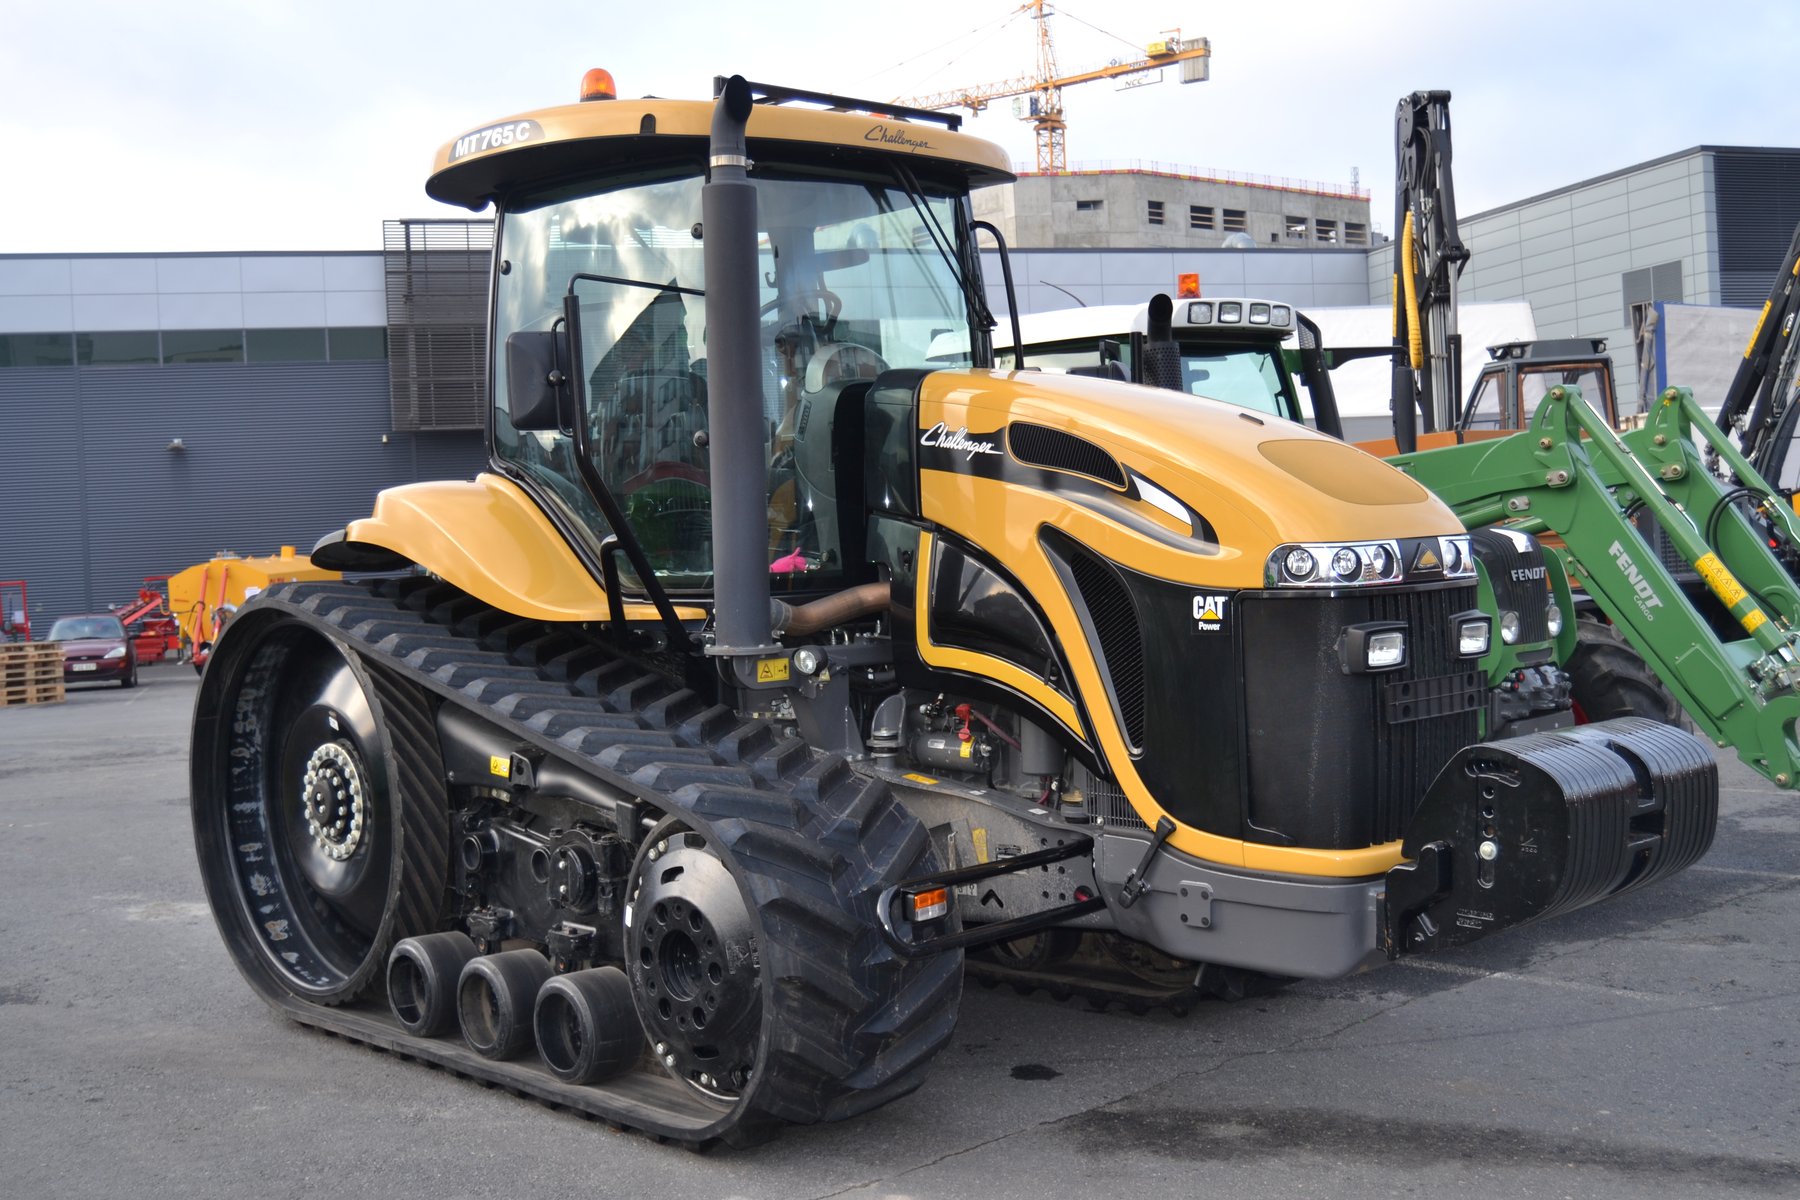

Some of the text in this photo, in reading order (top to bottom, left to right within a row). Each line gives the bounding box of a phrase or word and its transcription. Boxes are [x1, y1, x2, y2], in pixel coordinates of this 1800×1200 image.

[864, 124, 938, 152] Challenger
[920, 421, 1004, 461] Challenger
[1510, 566, 1546, 581] FENDT
[1608, 540, 1663, 608] FENDT
[1192, 595, 1225, 620] CAT
[1633, 595, 1654, 621] CARGO
[1198, 621, 1221, 631] Power
